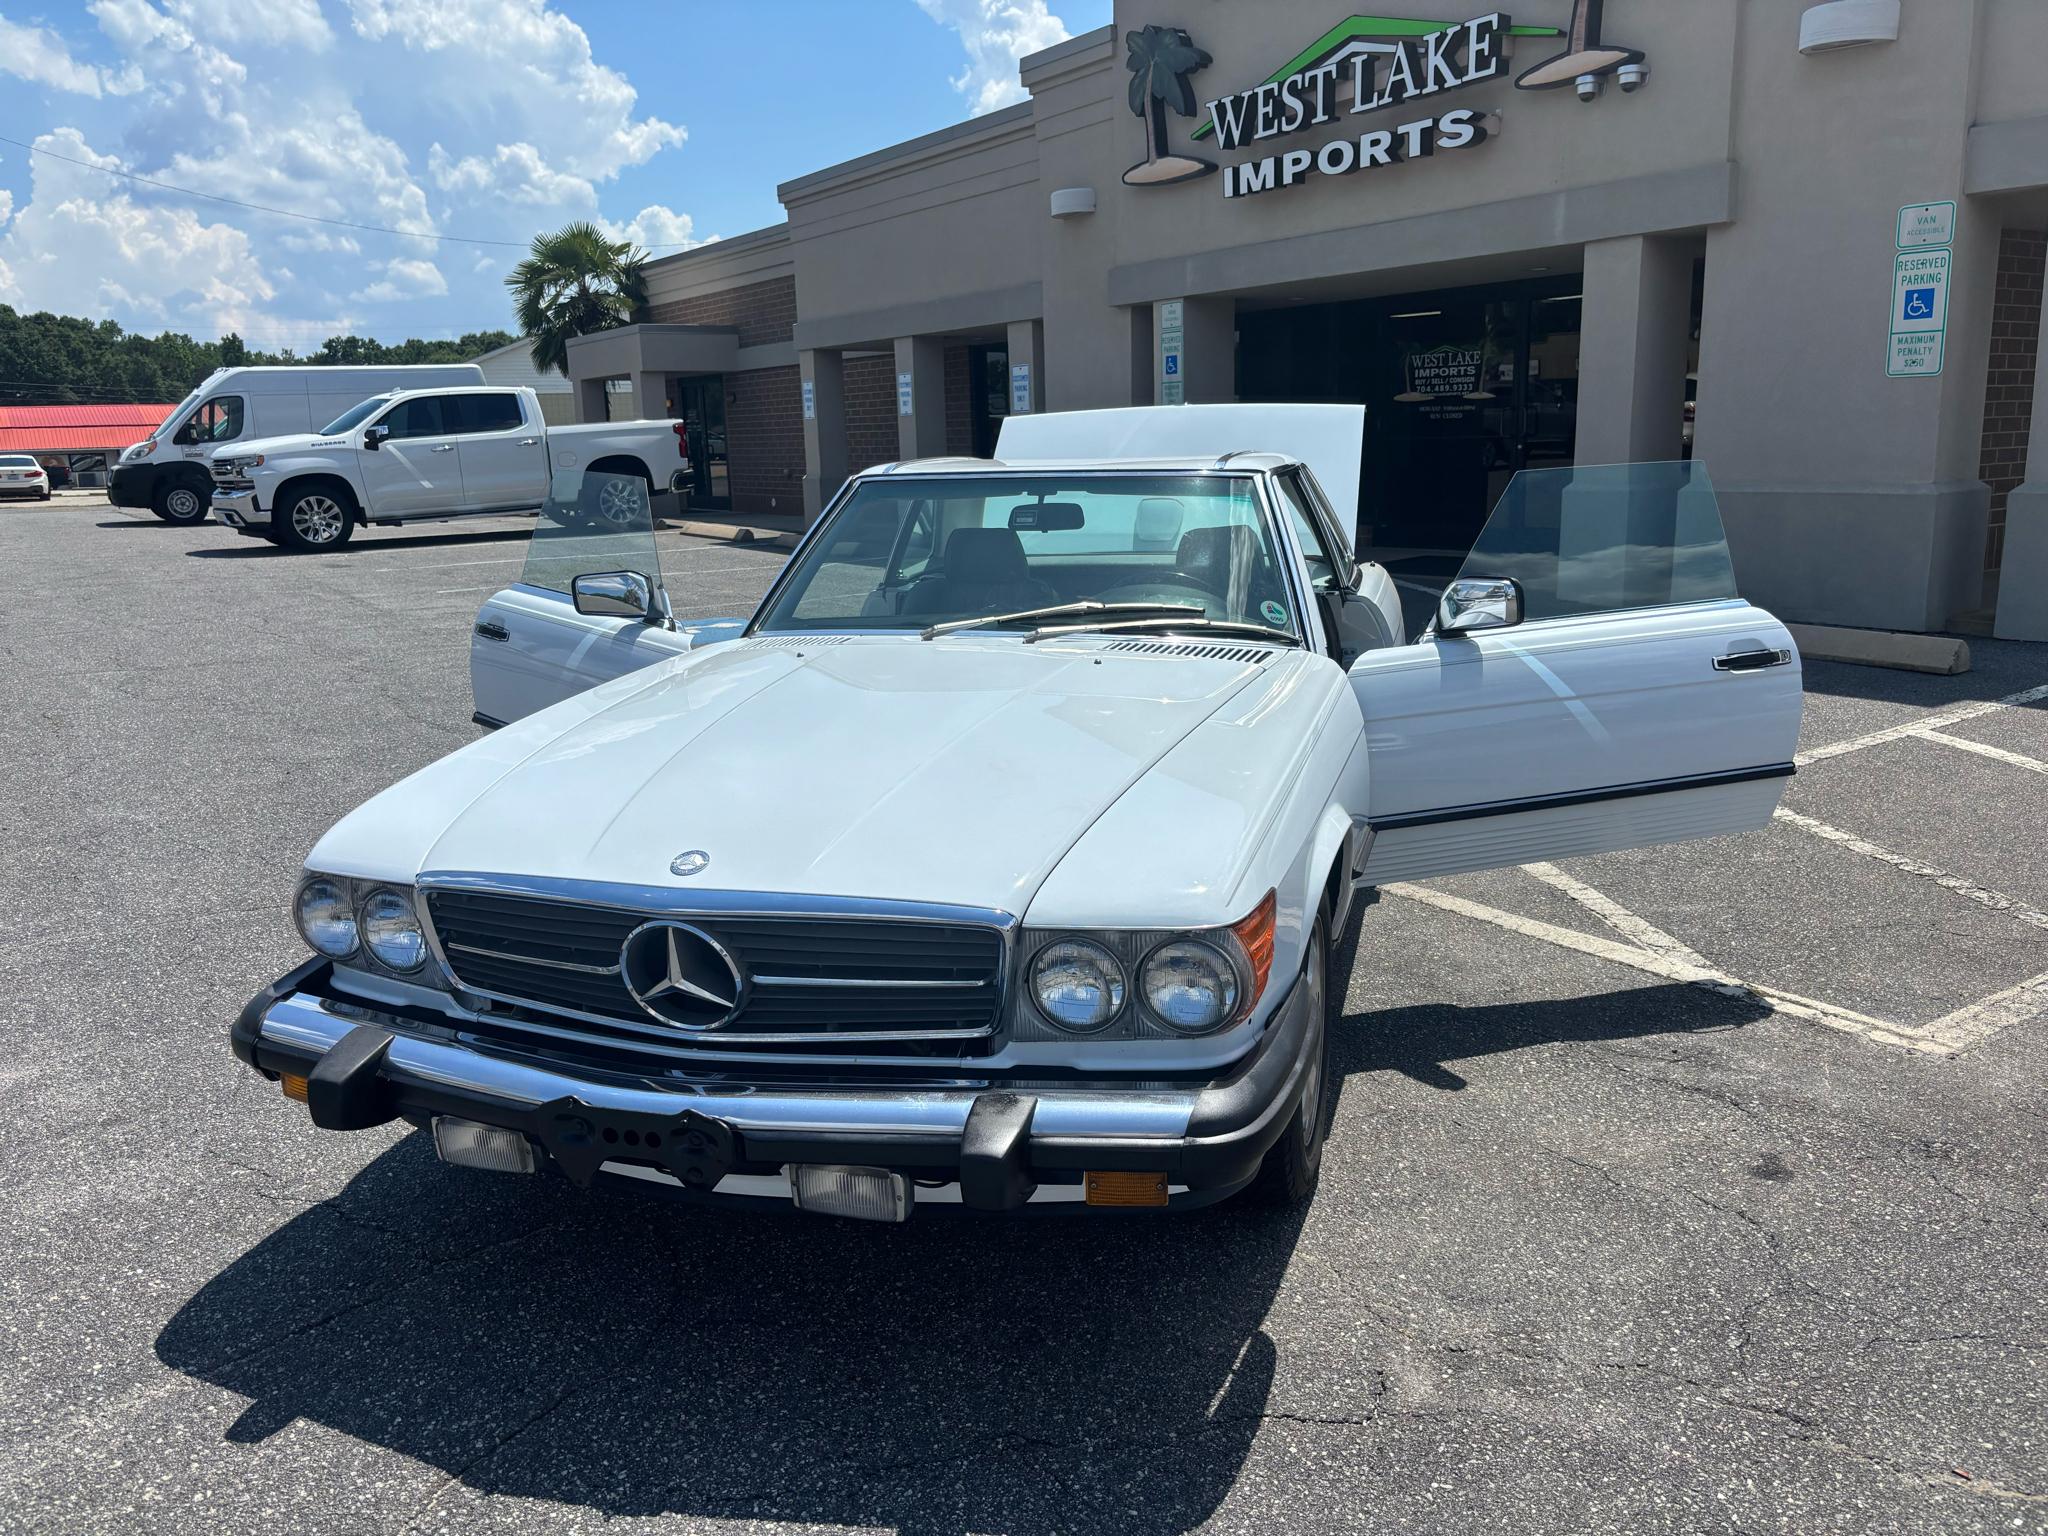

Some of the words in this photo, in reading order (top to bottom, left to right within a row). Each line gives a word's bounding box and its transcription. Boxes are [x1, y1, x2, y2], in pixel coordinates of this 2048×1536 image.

[1205, 65, 1337, 150] WEST
[1349, 12, 1502, 113] LAKE
[1222, 108, 1479, 199] IMPORTS
[1916, 215, 1936, 225] VAN
[1907, 227, 1945, 236] ACCESSIBLE
[1897, 256, 1947, 273] RESERVED
[1901, 273, 1942, 287] PARKING
[1897, 335, 1936, 345] MAXIMUM
[1897, 347, 1933, 357] PENALTY
[1411, 354, 1445, 367] WEST
[1448, 351, 1480, 365] LAKE
[1415, 366, 1475, 377] IMPORTS
